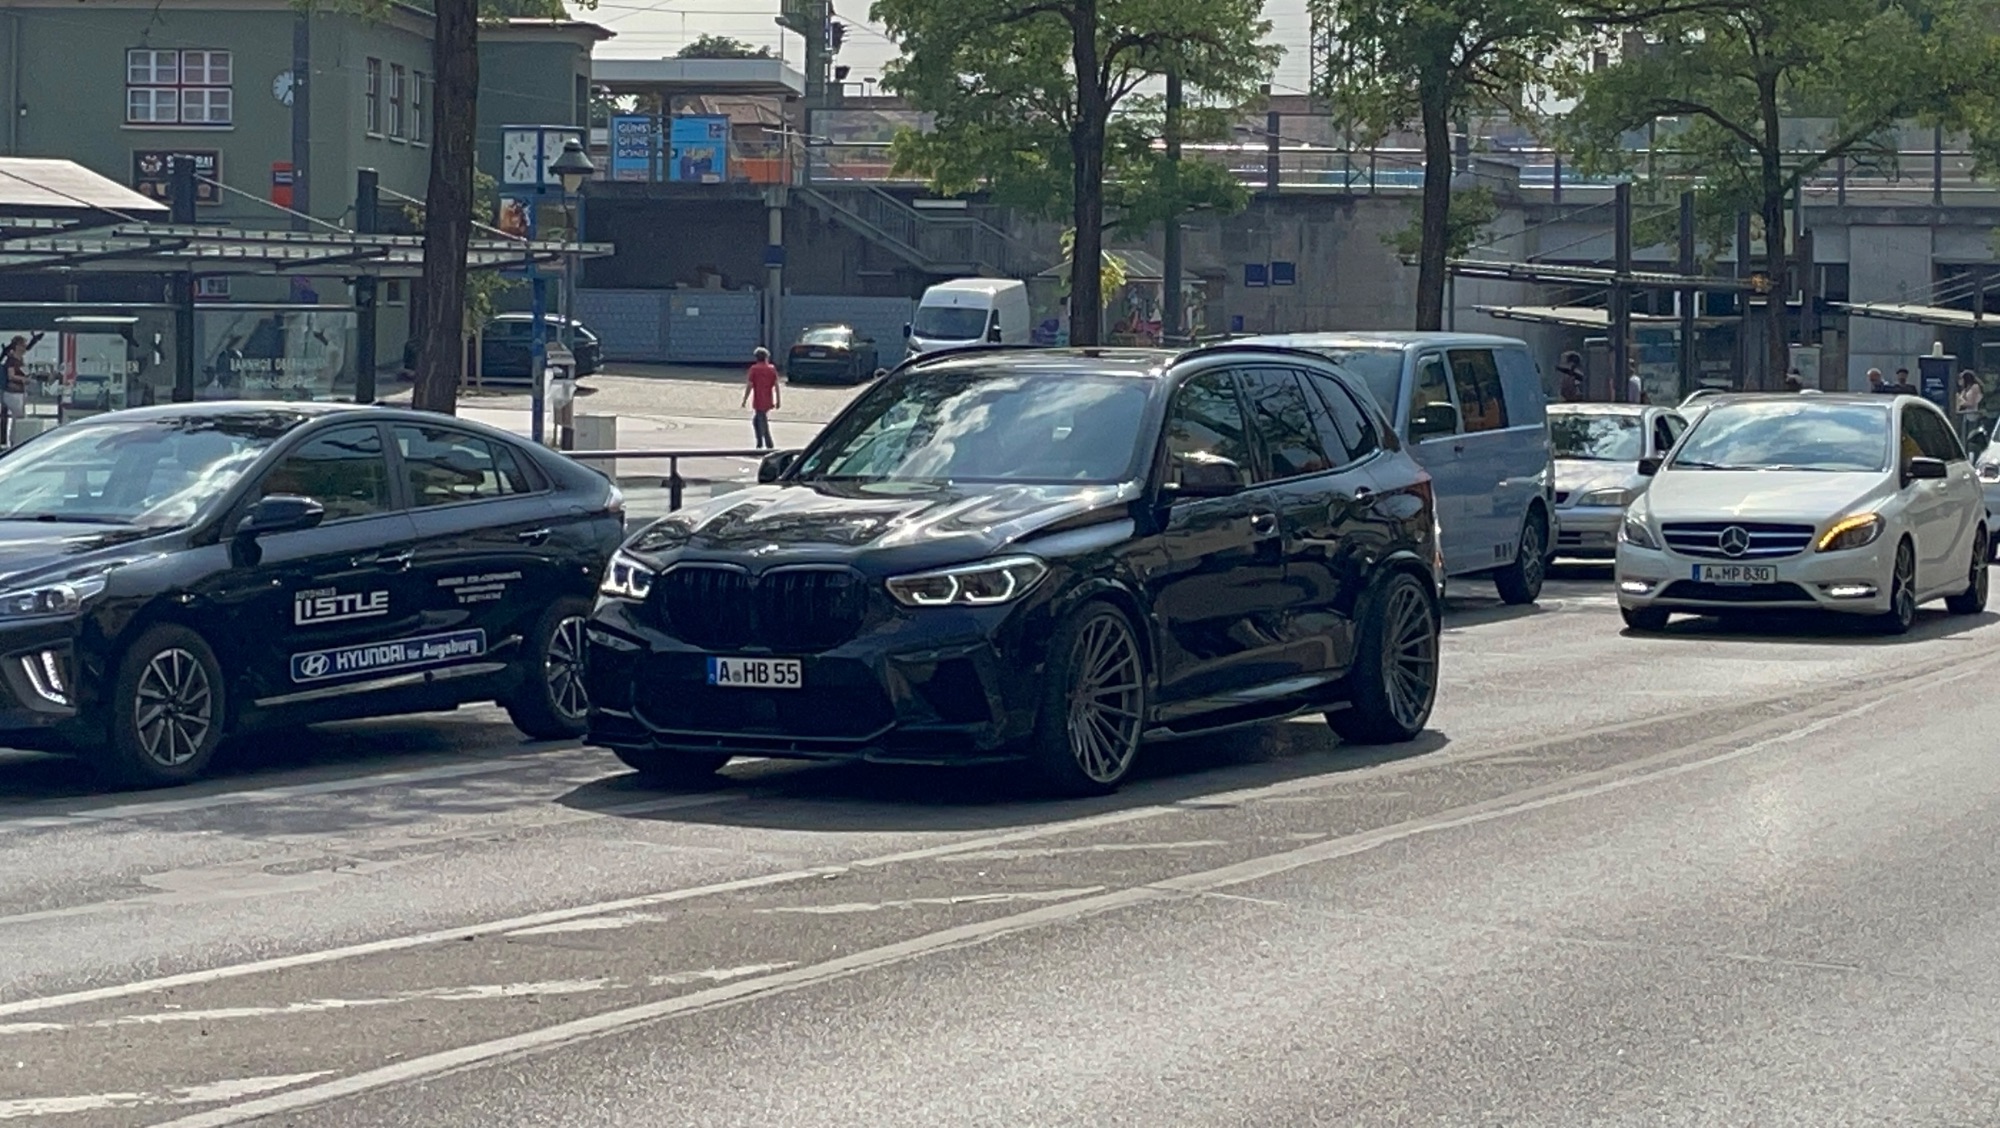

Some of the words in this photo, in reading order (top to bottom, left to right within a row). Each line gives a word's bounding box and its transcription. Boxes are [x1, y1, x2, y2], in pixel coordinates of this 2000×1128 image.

[336, 644, 405, 670] HYUNDAI
[422, 639, 478, 660] Augsburg
[719, 660, 731, 683] A
[743, 661, 770, 684] HB
[774, 663, 799, 685] 55
